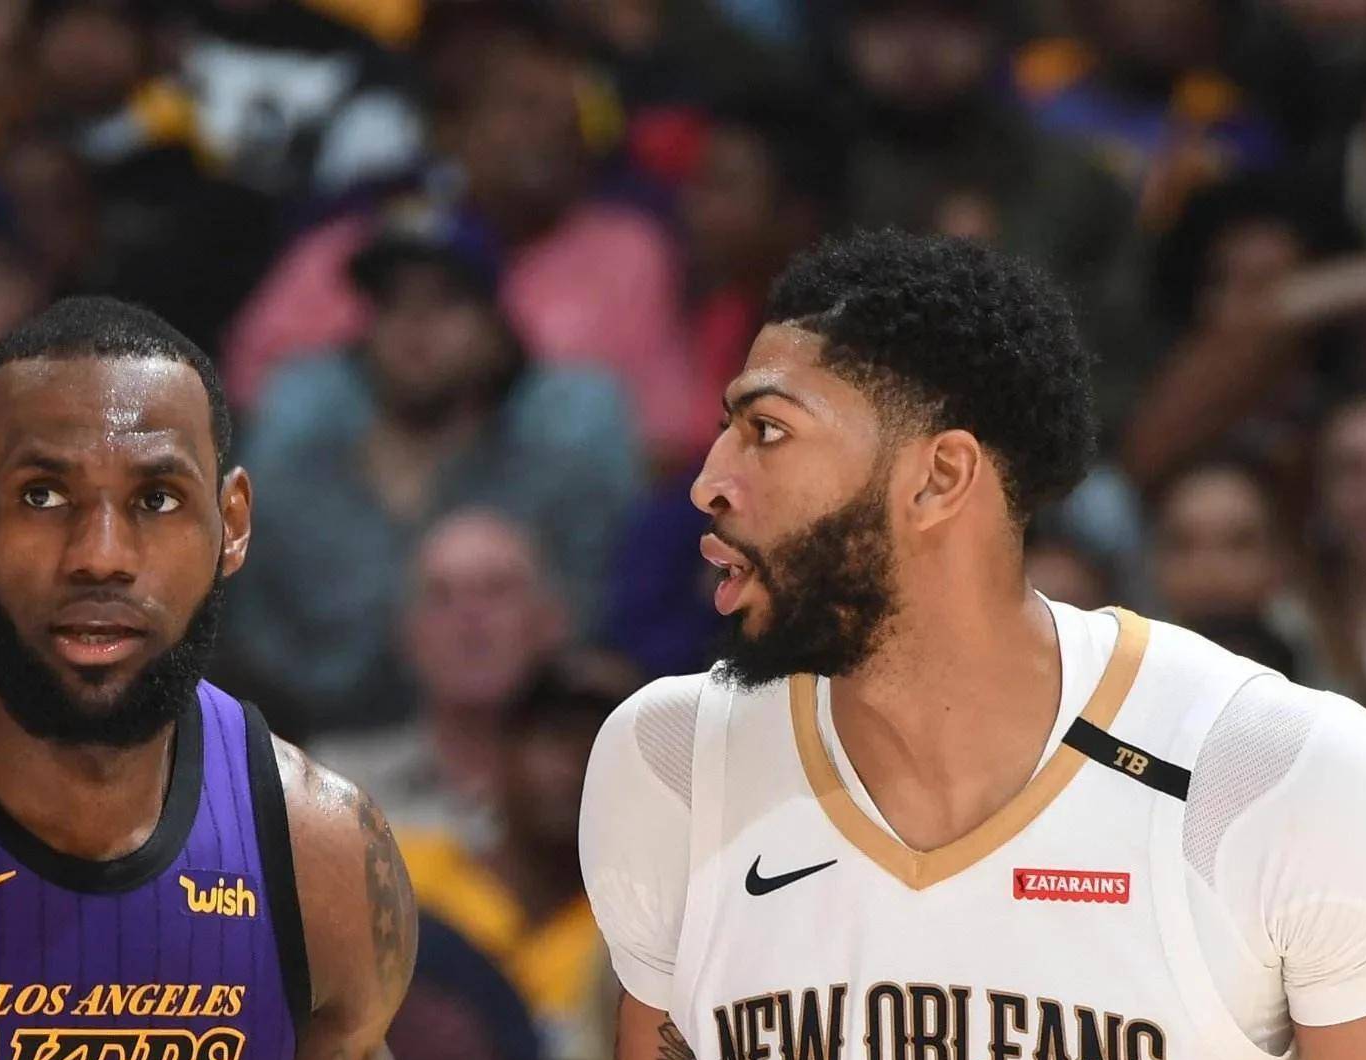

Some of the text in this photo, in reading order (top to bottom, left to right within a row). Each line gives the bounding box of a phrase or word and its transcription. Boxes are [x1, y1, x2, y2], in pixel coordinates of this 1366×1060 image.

[1113, 746, 1149, 775] TB
[179, 875, 255, 917] wish
[72, 984, 246, 1016] ANGELES
